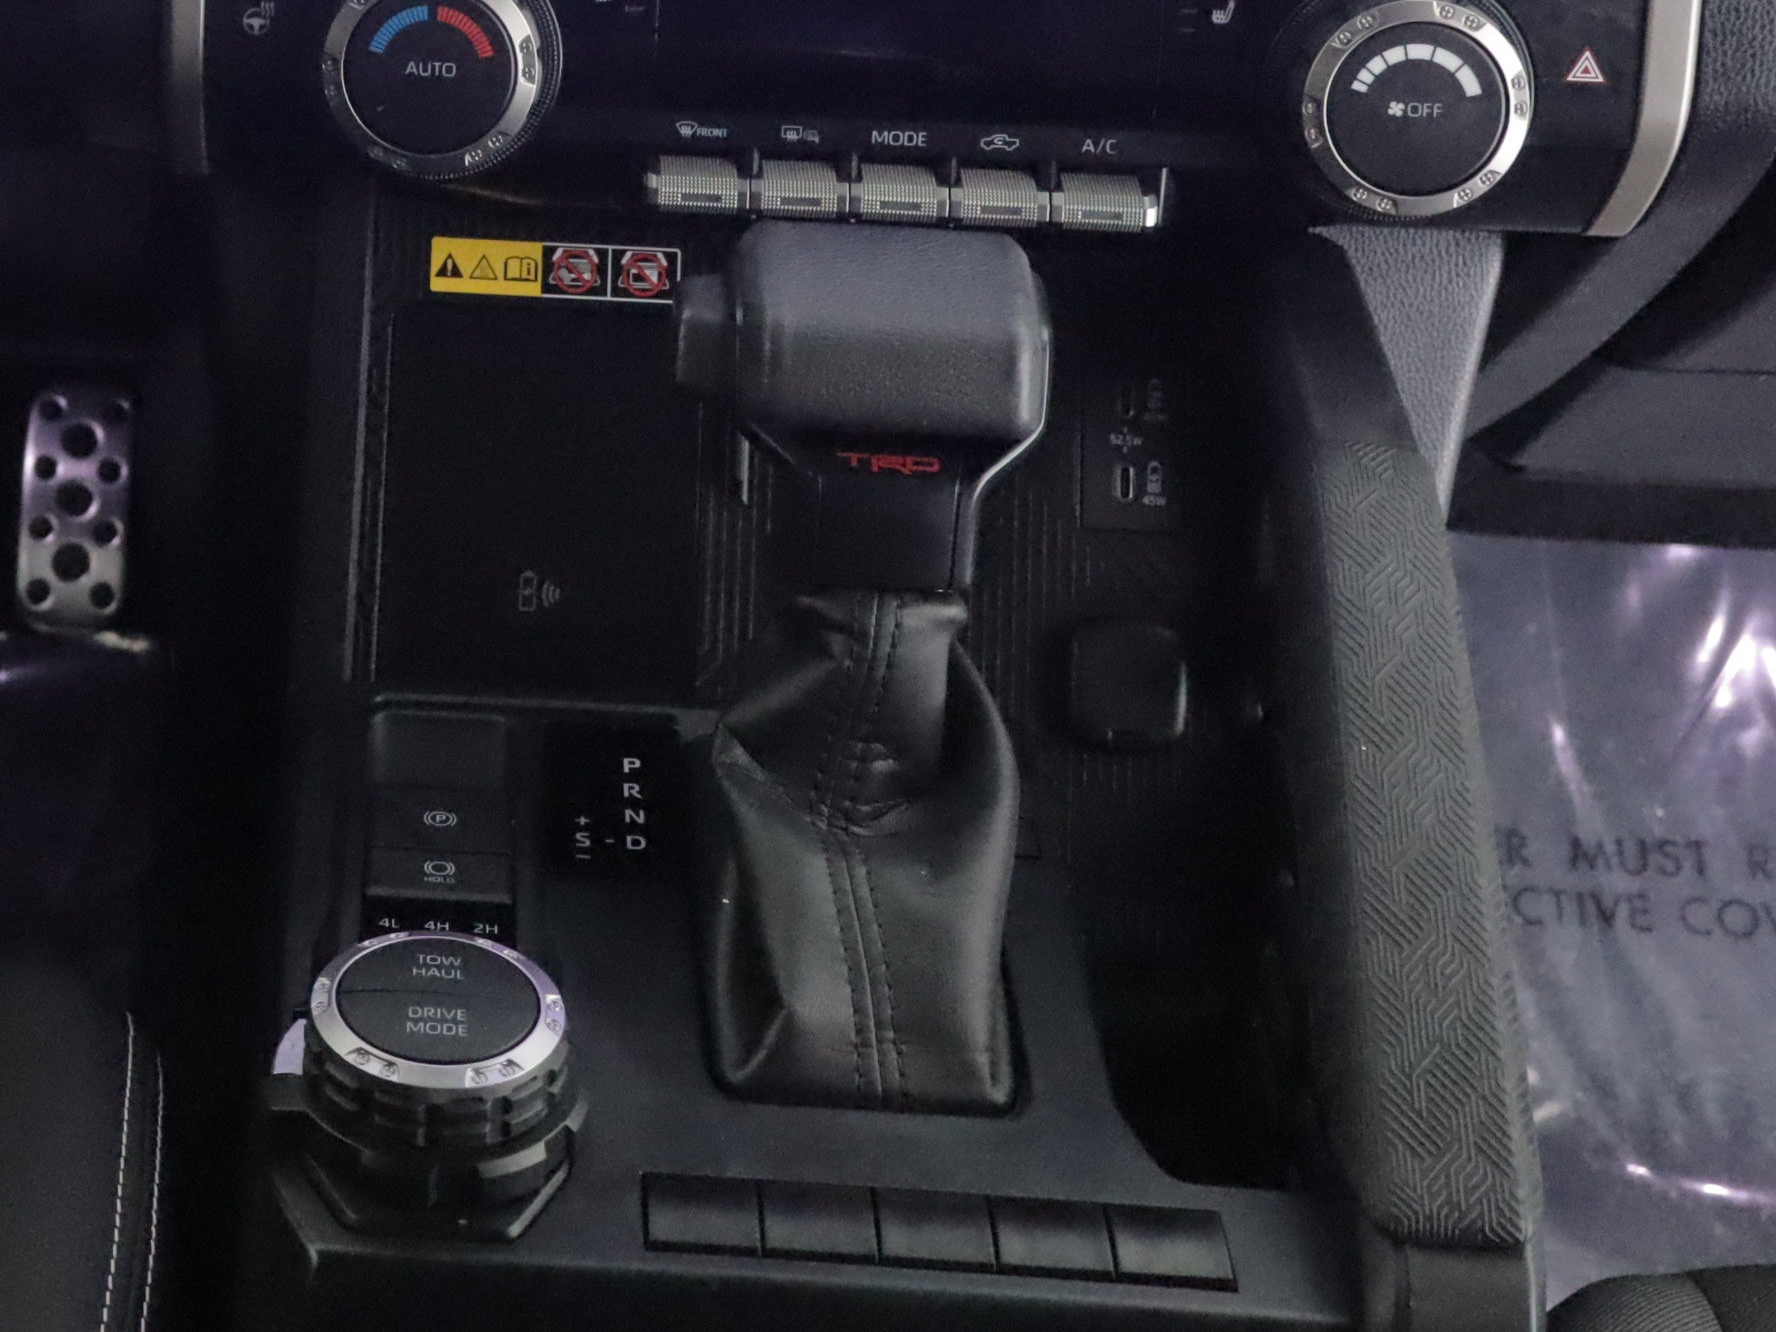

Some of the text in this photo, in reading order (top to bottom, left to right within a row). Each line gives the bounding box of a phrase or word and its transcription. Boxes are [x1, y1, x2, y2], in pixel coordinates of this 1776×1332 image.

[405, 61, 457, 78] AUTO
[1406, 102, 1443, 119] OFF
[696, 128, 728, 138] FRONT
[871, 130, 928, 149] MODE
[1081, 137, 1118, 156] A/C
[836, 451, 943, 475] TRD
[622, 757, 642, 773] P
[623, 783, 643, 799] R
[624, 809, 645, 825] N
[574, 832, 591, 848] S
[625, 835, 647, 851] D
[1568, 834, 1708, 877] MUST
[423, 876, 456, 884] HOLD
[378, 917, 499, 935] 4L 4H 2H
[416, 953, 462, 967] TOW
[412, 966, 465, 979] HAUL
[407, 1006, 468, 1021] DRIVE
[406, 1021, 469, 1037] MODE
